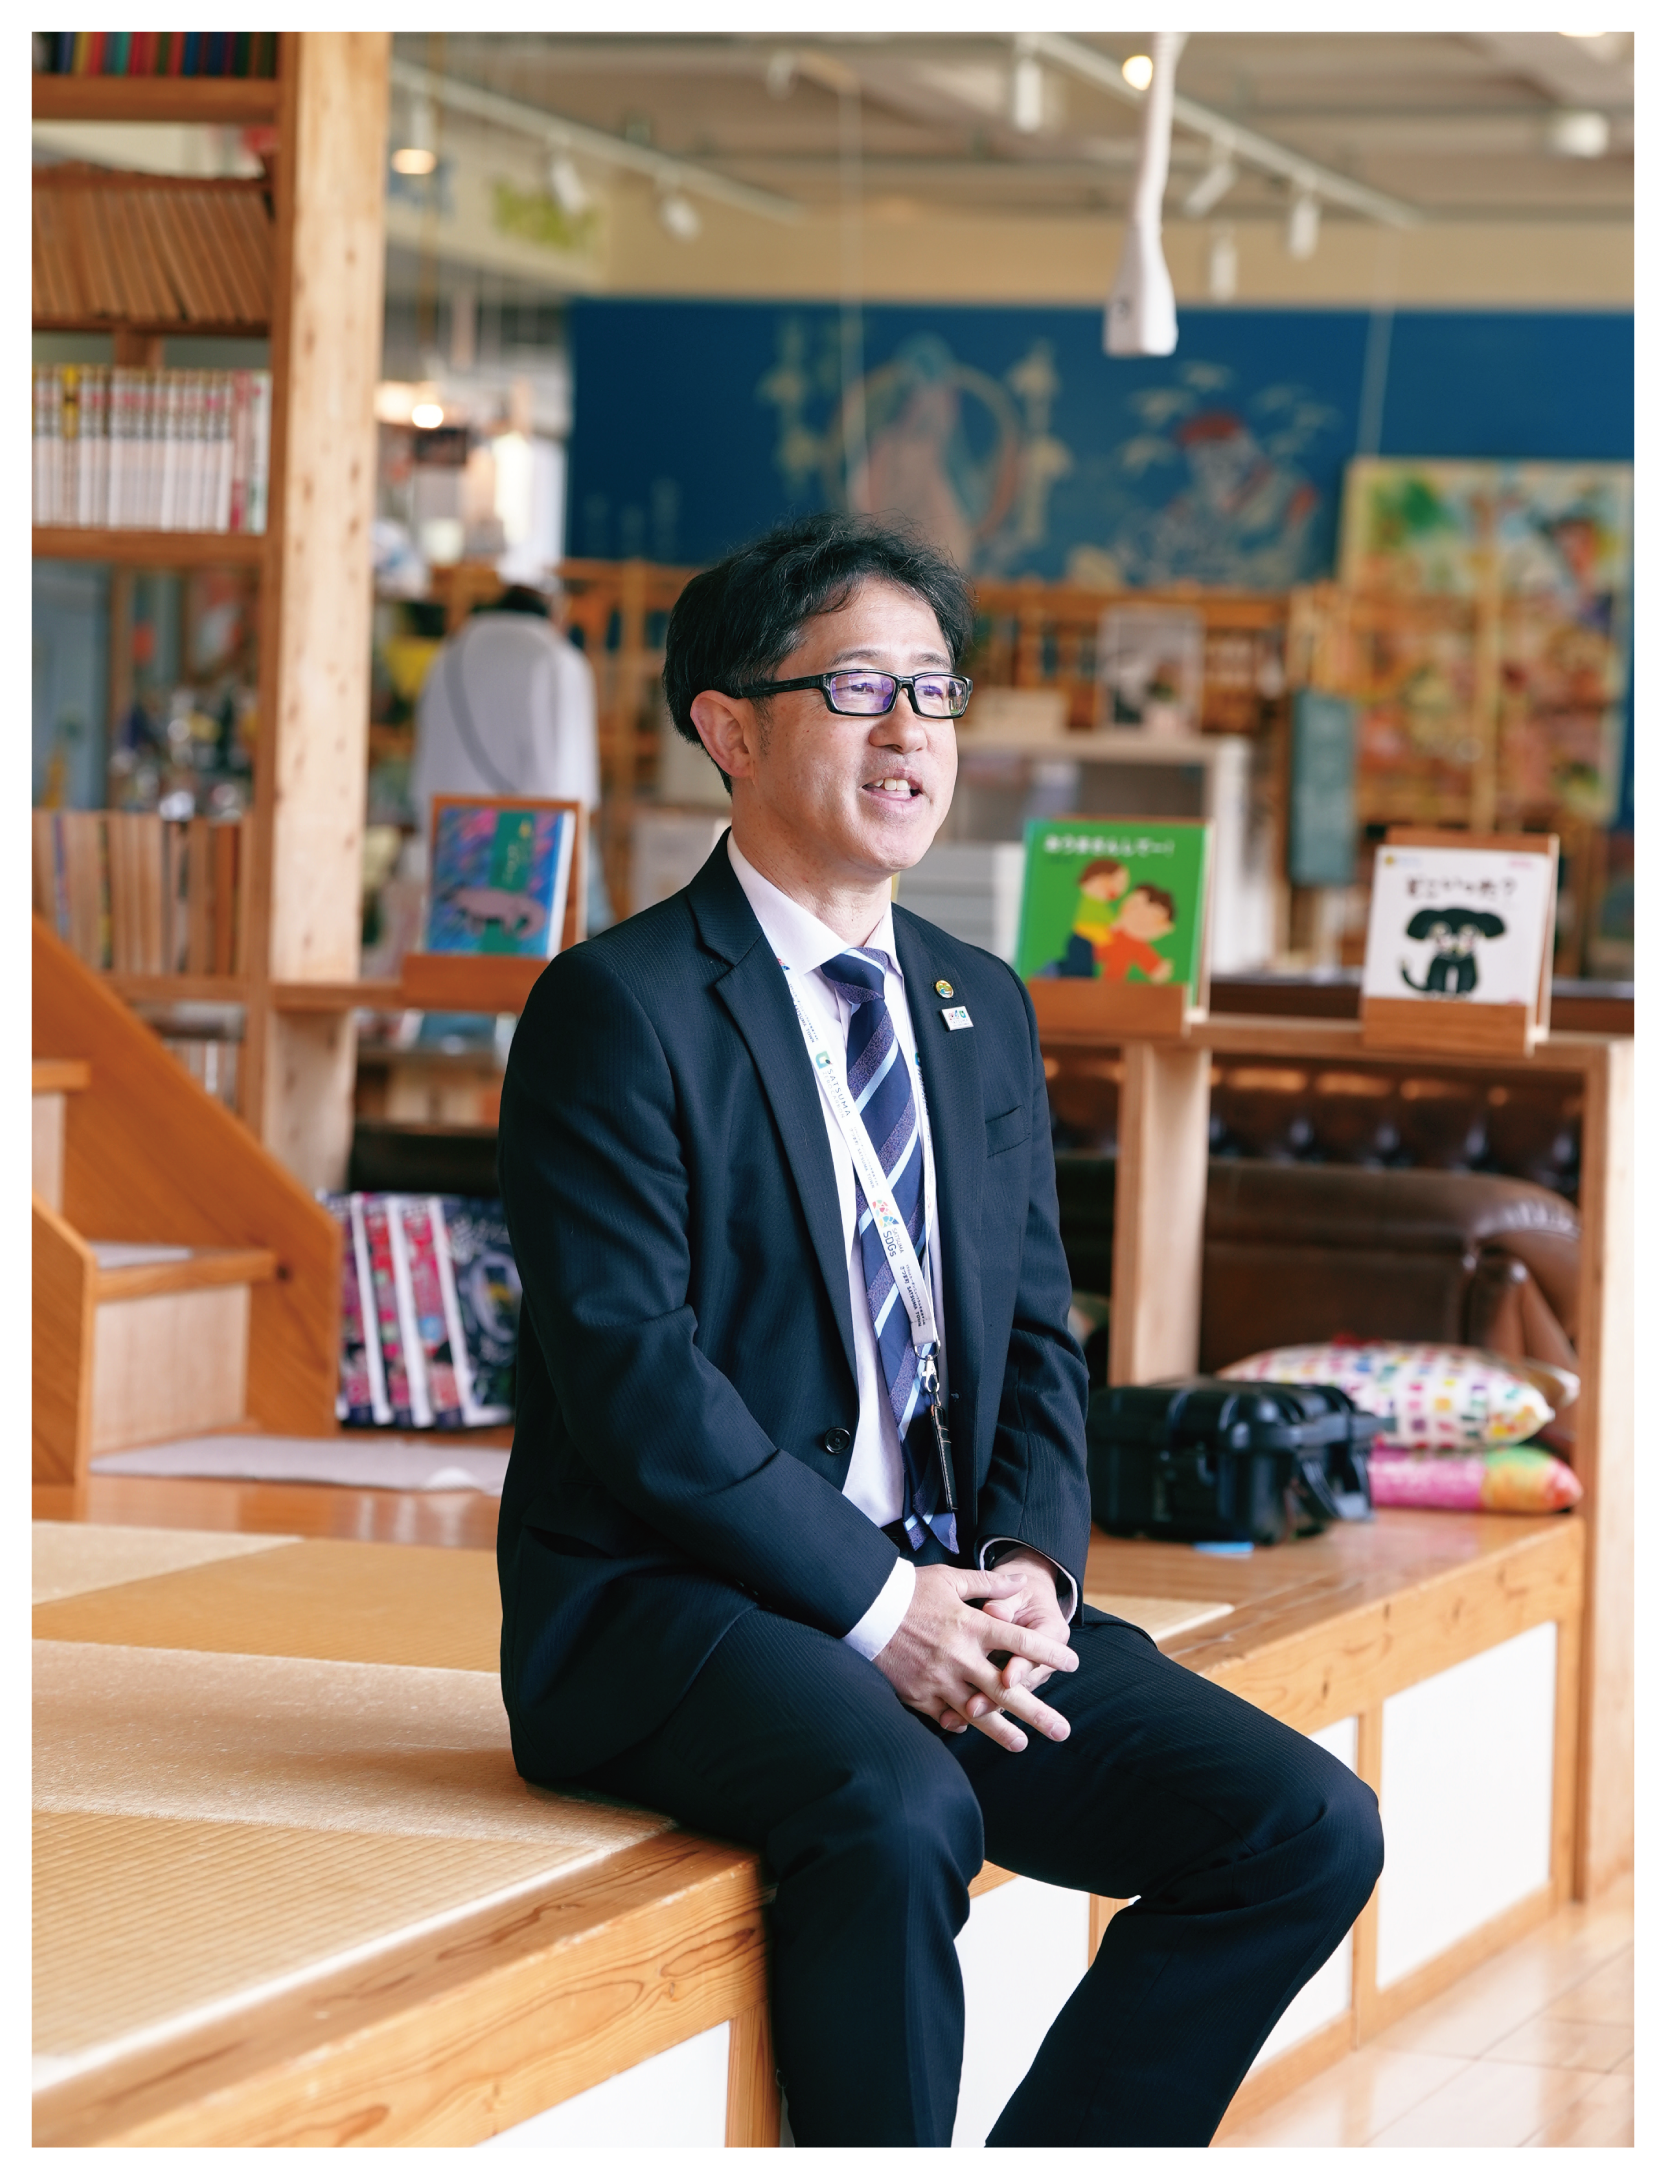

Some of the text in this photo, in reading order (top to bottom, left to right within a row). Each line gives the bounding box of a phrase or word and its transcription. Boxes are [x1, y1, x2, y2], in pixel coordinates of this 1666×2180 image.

[827, 1068, 851, 1116] SATSUMA
[857, 1148, 868, 1171] SATSUMA
[866, 1173, 875, 1188] TOWN
[882, 1229, 897, 1257] SDGs
[891, 1227, 904, 1253] SATSUMA
[906, 1285, 918, 1309] SATSUMA
